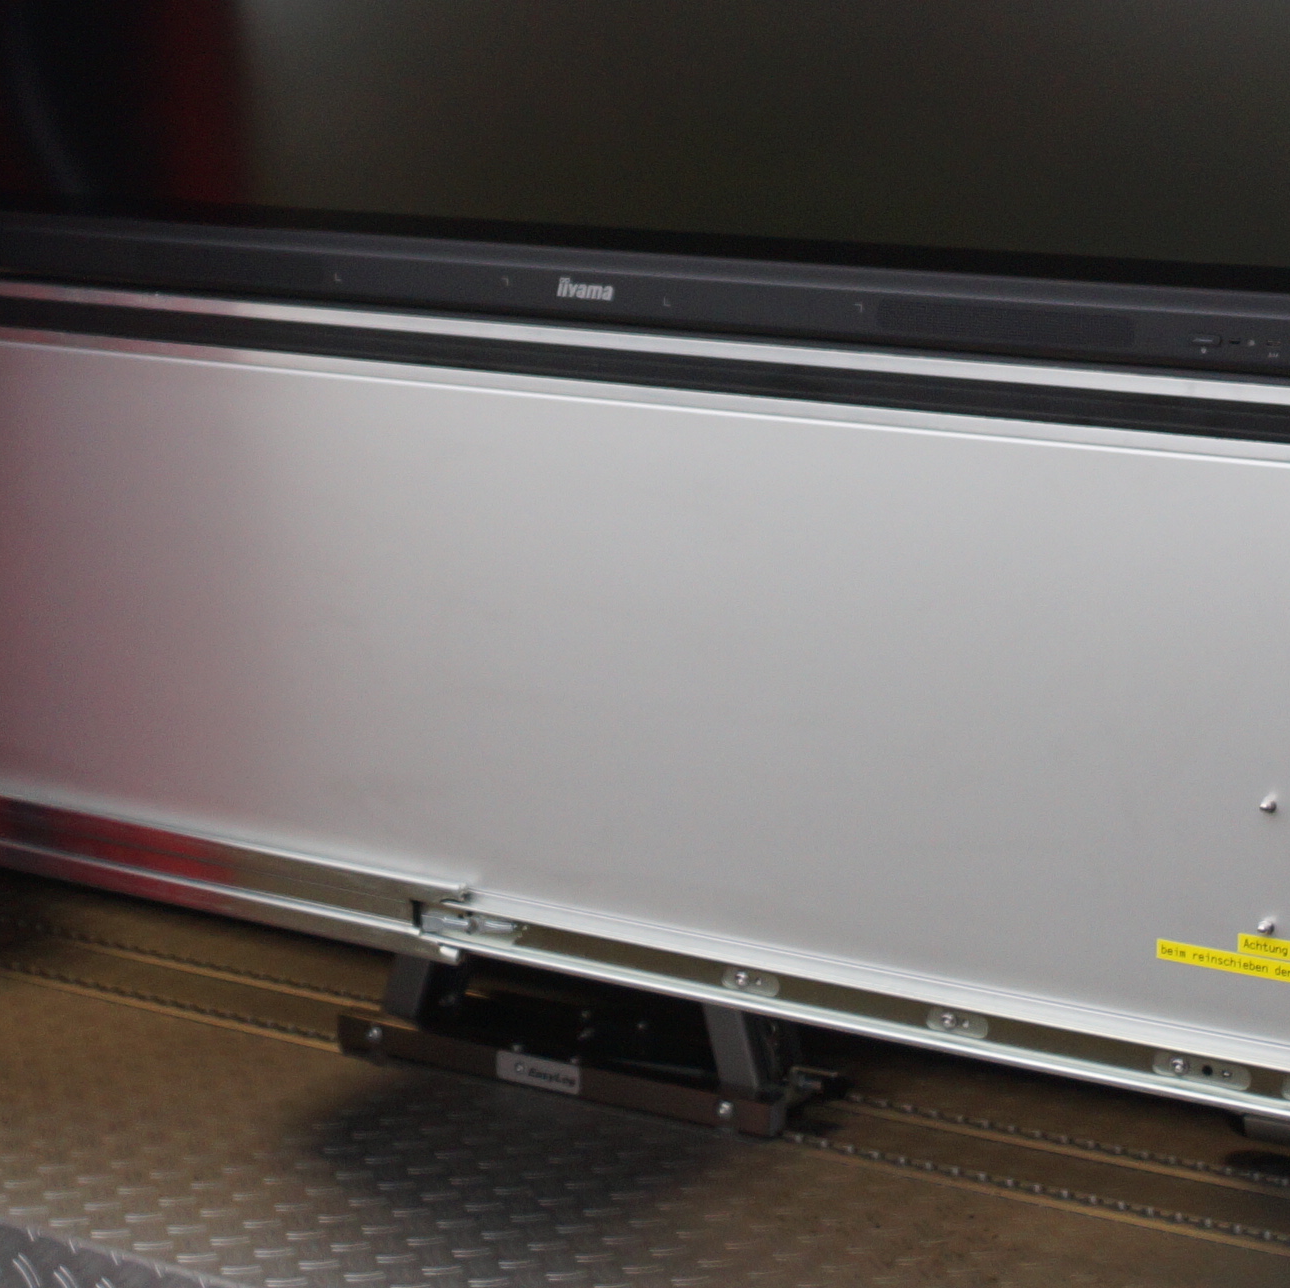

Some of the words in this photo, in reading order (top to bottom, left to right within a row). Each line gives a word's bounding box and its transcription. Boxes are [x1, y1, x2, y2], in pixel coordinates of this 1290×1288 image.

[556, 277, 614, 301] iiyama
[1161, 943, 1186, 958] beim
[1193, 951, 1268, 973] reinschieben
[1243, 939, 1289, 957] Achtung
